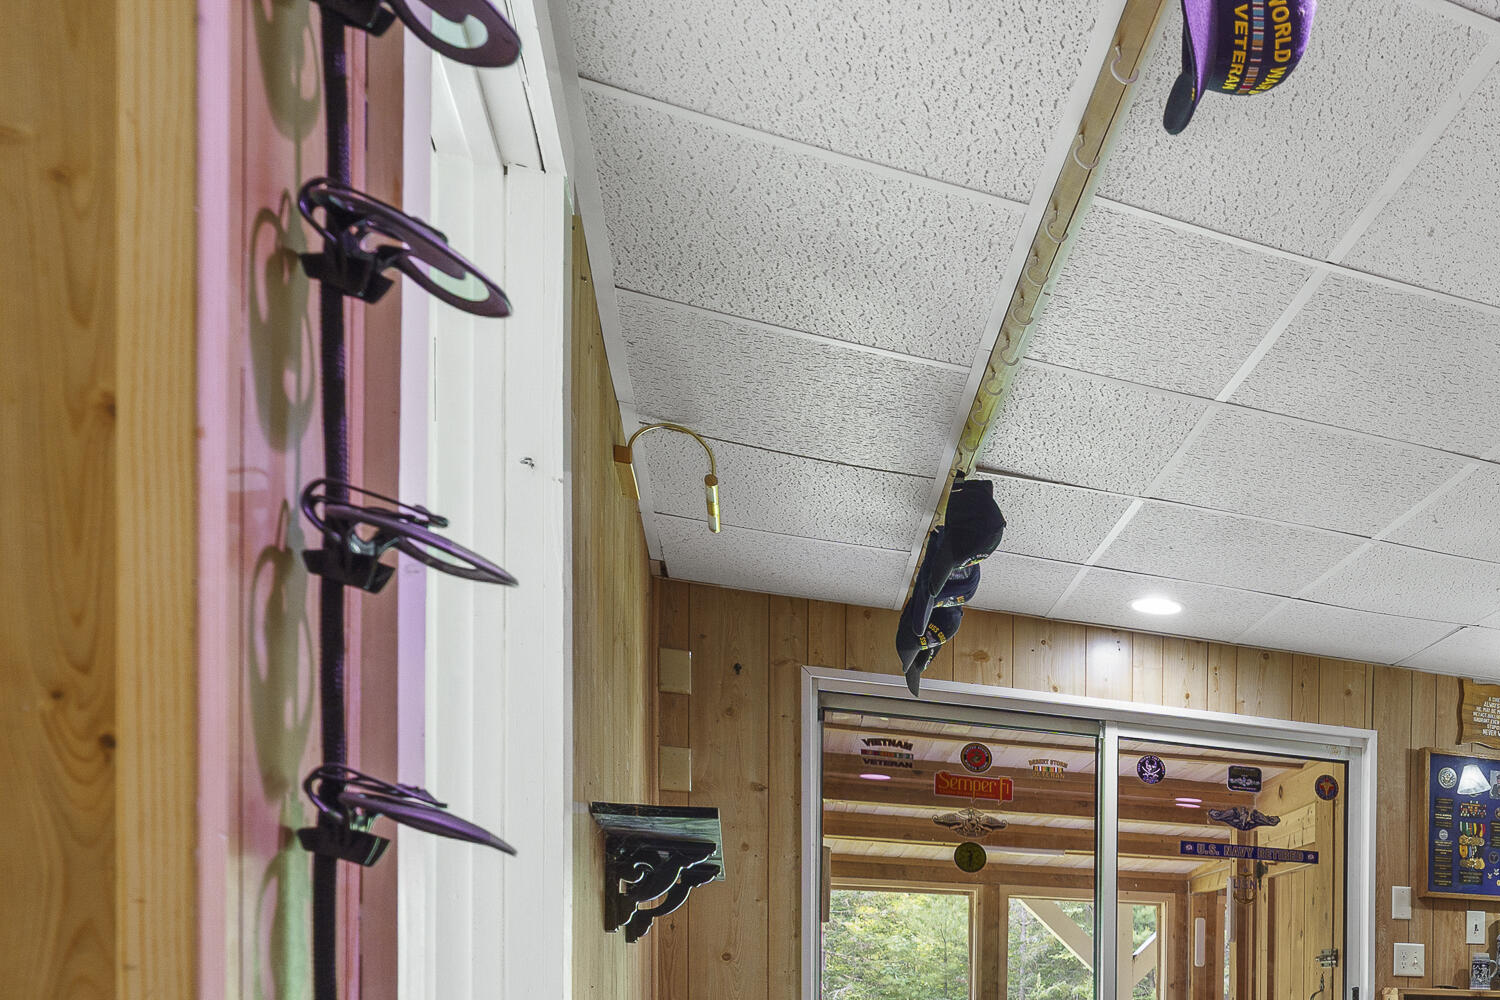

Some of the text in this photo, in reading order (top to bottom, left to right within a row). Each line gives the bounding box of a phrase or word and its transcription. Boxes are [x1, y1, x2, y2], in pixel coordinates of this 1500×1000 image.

[1222, 3, 1249, 90] VETERAN
[1482, 728, 1497, 736] NEVER
[861, 737, 914, 751] VIETNAM
[862, 757, 913, 769] VETERAN
[937, 771, 998, 799] Semper
[1196, 843, 1304, 862] U.S. NAVY RETIRED
